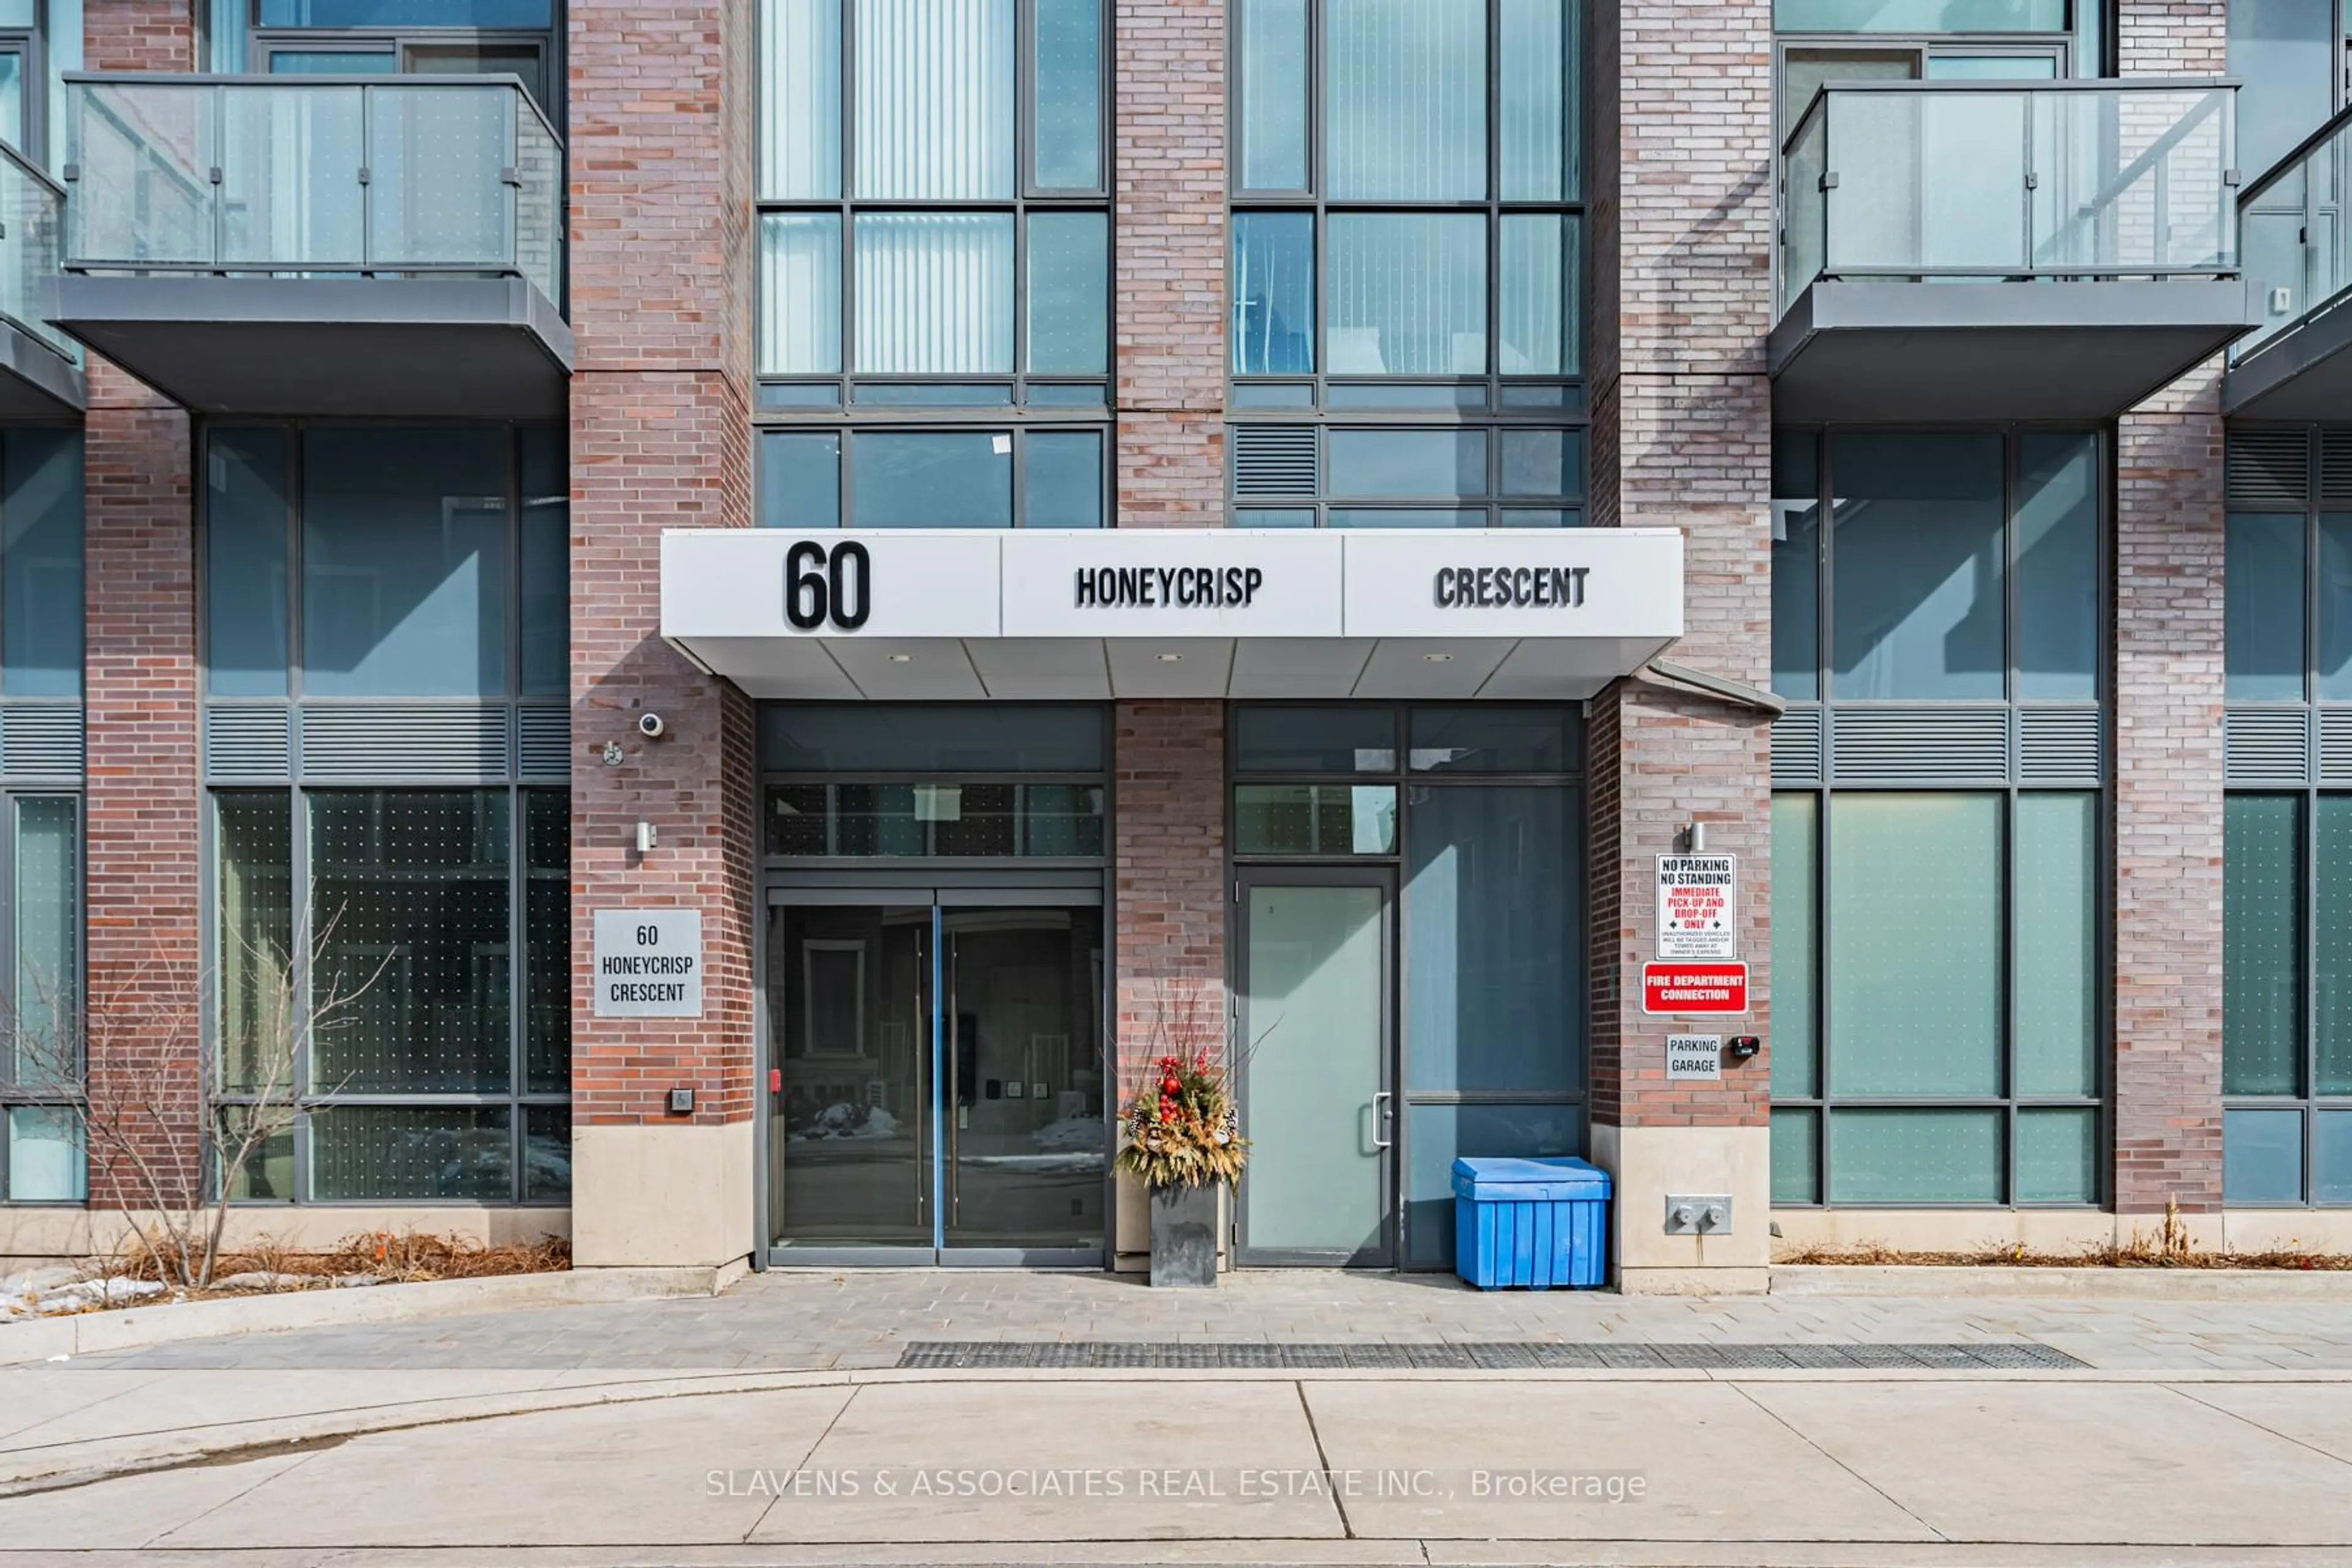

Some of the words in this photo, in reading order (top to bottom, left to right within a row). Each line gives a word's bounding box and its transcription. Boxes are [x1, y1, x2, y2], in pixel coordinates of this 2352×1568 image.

[785, 541, 870, 629] 60
[1077, 567, 1262, 605] HONEYCRISP
[1437, 567, 1590, 606] CRESCENT
[1663, 859, 1678, 871] NO
[1681, 859, 1729, 871] PARKING
[1660, 873, 1675, 884] NO
[1678, 873, 1731, 884] STANDING
[1672, 888, 1720, 897] IMMEDIATE
[1668, 898, 1703, 907] PICK-UP
[1706, 898, 1724, 907] AND
[1675, 909, 1717, 918] DROP-OFF
[1684, 920, 1705, 929] ONLY
[637, 925, 658, 946] 60
[603, 957, 693, 974] HONEYCRISP
[1647, 976, 1670, 986] FIRE
[1674, 976, 1743, 986] DEPARTMENT
[611, 984, 685, 1001] CRESCENT
[1660, 989, 1729, 1000] CONNECTION
[1671, 1040, 1717, 1052] PARKING
[1672, 1060, 1715, 1072] GARAGE
